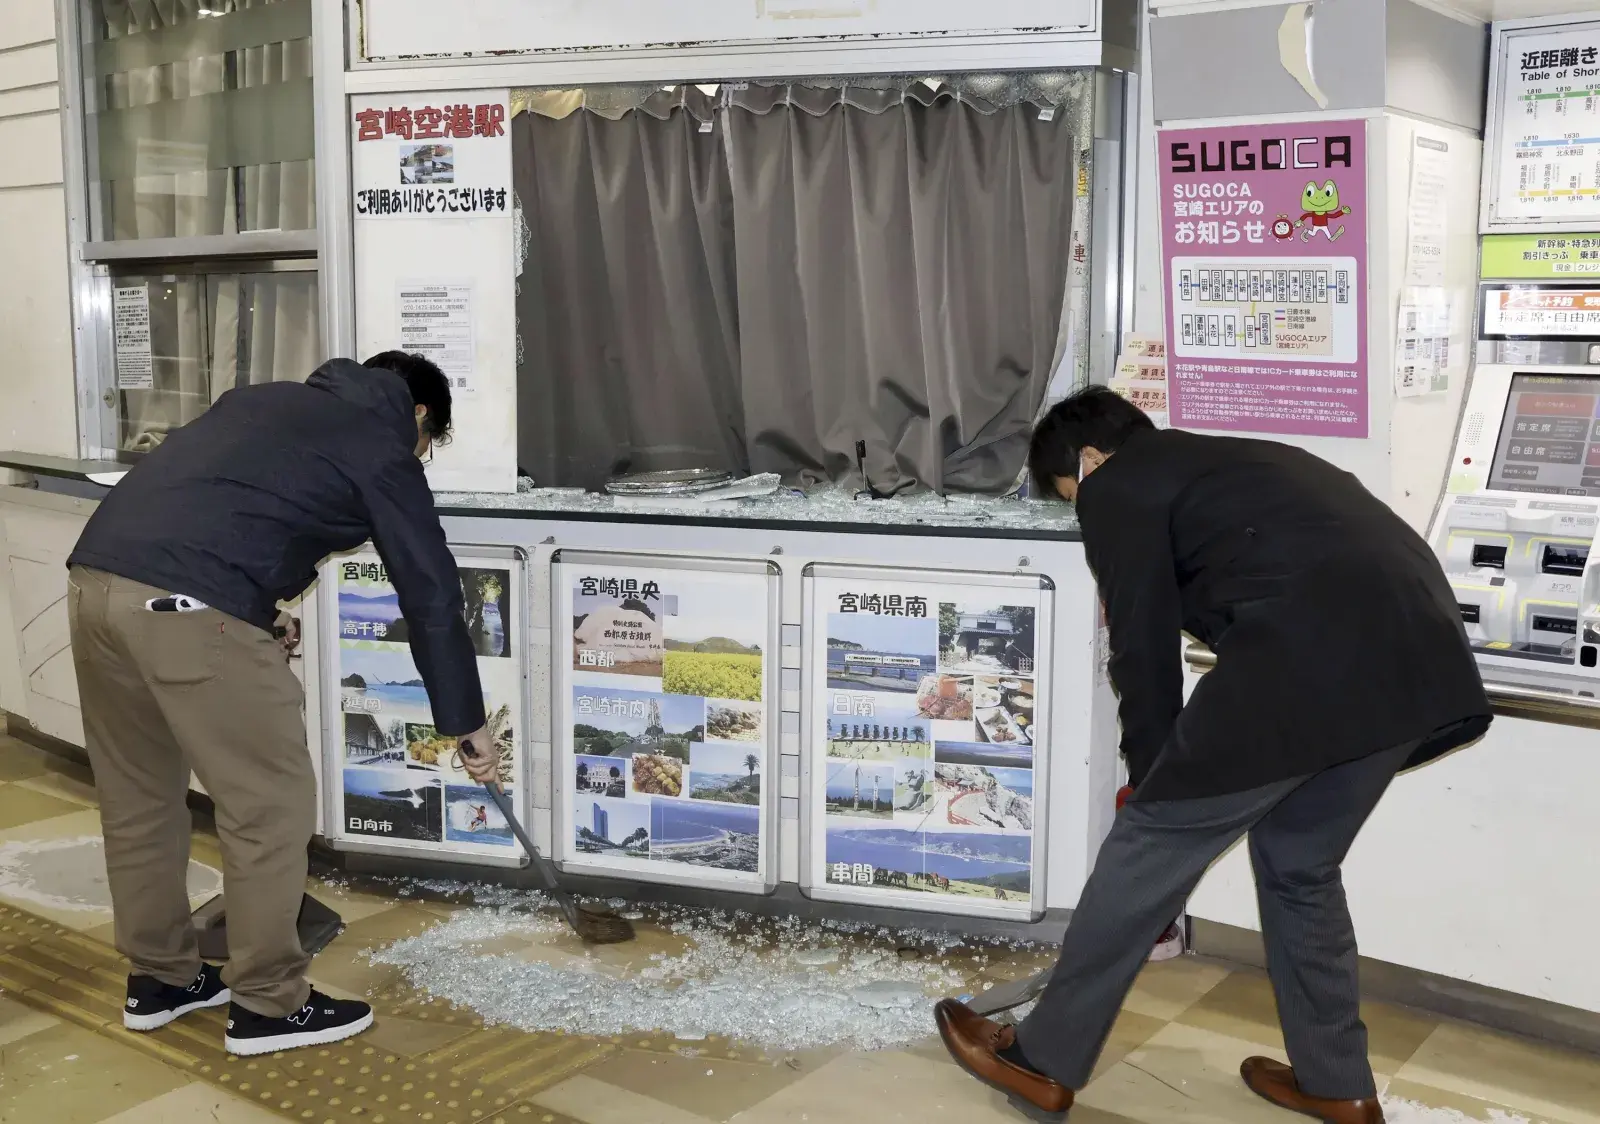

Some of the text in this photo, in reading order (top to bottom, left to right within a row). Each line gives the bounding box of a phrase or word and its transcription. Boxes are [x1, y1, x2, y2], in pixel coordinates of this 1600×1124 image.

[1520, 47, 1598, 70] 近距離き
[1520, 67, 1600, 82] Table of Shor
[355, 103, 505, 142] 宮崎空港駅
[1171, 136, 1351, 173] SUGOCA
[1173, 182, 1252, 198] SUGOCA
[356, 187, 507, 215] ご利用ありがとうございます
[1173, 200, 1264, 217] 宮崎エリアの
[1174, 220, 1265, 245] お知らせ
[1537, 239, 1600, 249] 新幹線・特急列
[1522, 251, 1569, 260] 割引きっぷ
[1264, 278, 1272, 294] 宮崎
[1210, 324, 1217, 338] 木花
[1226, 324, 1233, 339] 南方
[1246, 324, 1254, 339] 田吉
[1261, 314, 1269, 344] 宮崎空港
[1275, 334, 1327, 342] SUGOCAエリア
[1516, 422, 1552, 433] 指定席
[1511, 445, 1546, 456] 自由席
[579, 576, 661, 602] 宮崎県央
[1551, 582, 1572, 590] おつり
[838, 592, 928, 618] 宮崎県南
[343, 620, 387, 637] 高千穂
[579, 649, 615, 668] 西都
[576, 694, 646, 719] 宮崎市内
[832, 693, 875, 717] 日南
[349, 817, 394, 833] 日向市
[831, 861, 873, 885] 串間
